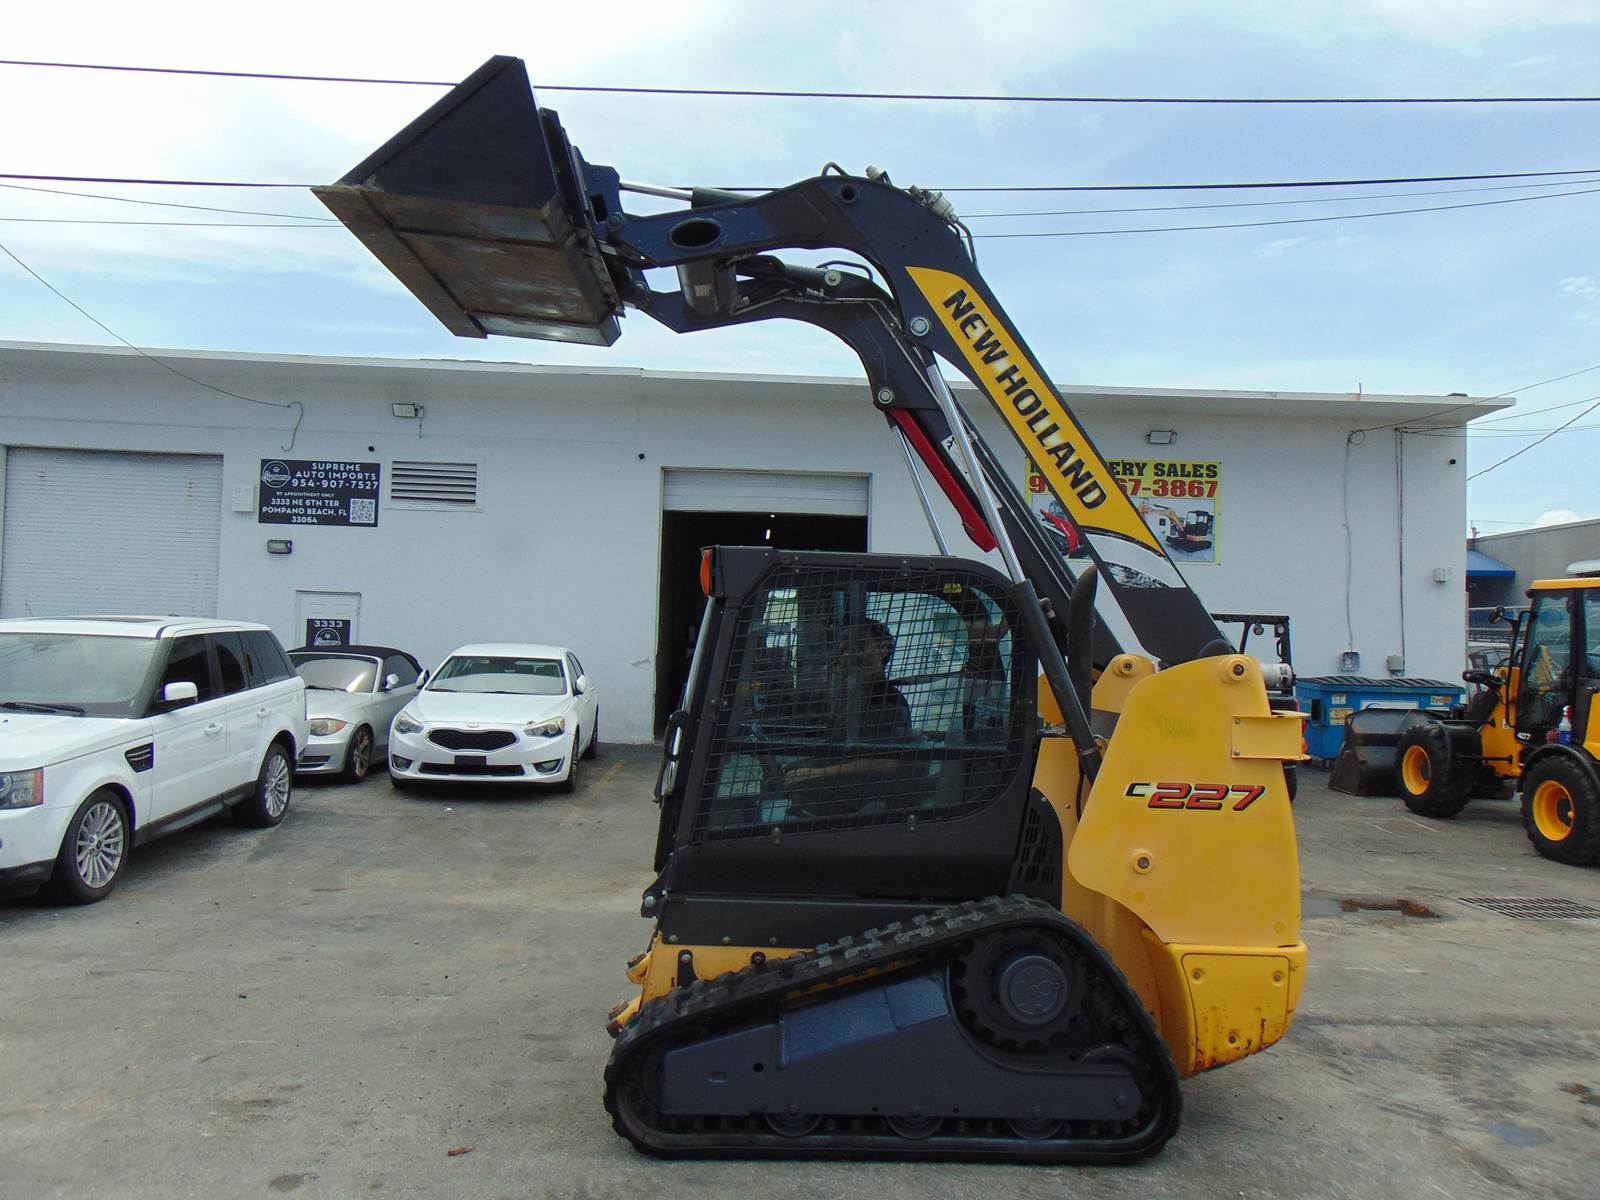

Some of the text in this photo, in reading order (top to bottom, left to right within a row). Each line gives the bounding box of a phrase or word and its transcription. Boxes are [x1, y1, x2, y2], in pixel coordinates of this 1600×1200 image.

[942, 288, 1009, 365] NEW
[995, 363, 1107, 510] HOLLAND
[312, 463, 360, 471] SUPREME
[1153, 463, 1218, 478] SALES
[329, 472, 376, 480] IMPORTS
[291, 479, 378, 489] 954-907-7527
[292, 498, 303, 506] NE
[305, 499, 322, 507] 6TH
[324, 499, 339, 507] TER
[262, 506, 305, 515] POMPANO
[1125, 782, 1266, 812] C227
